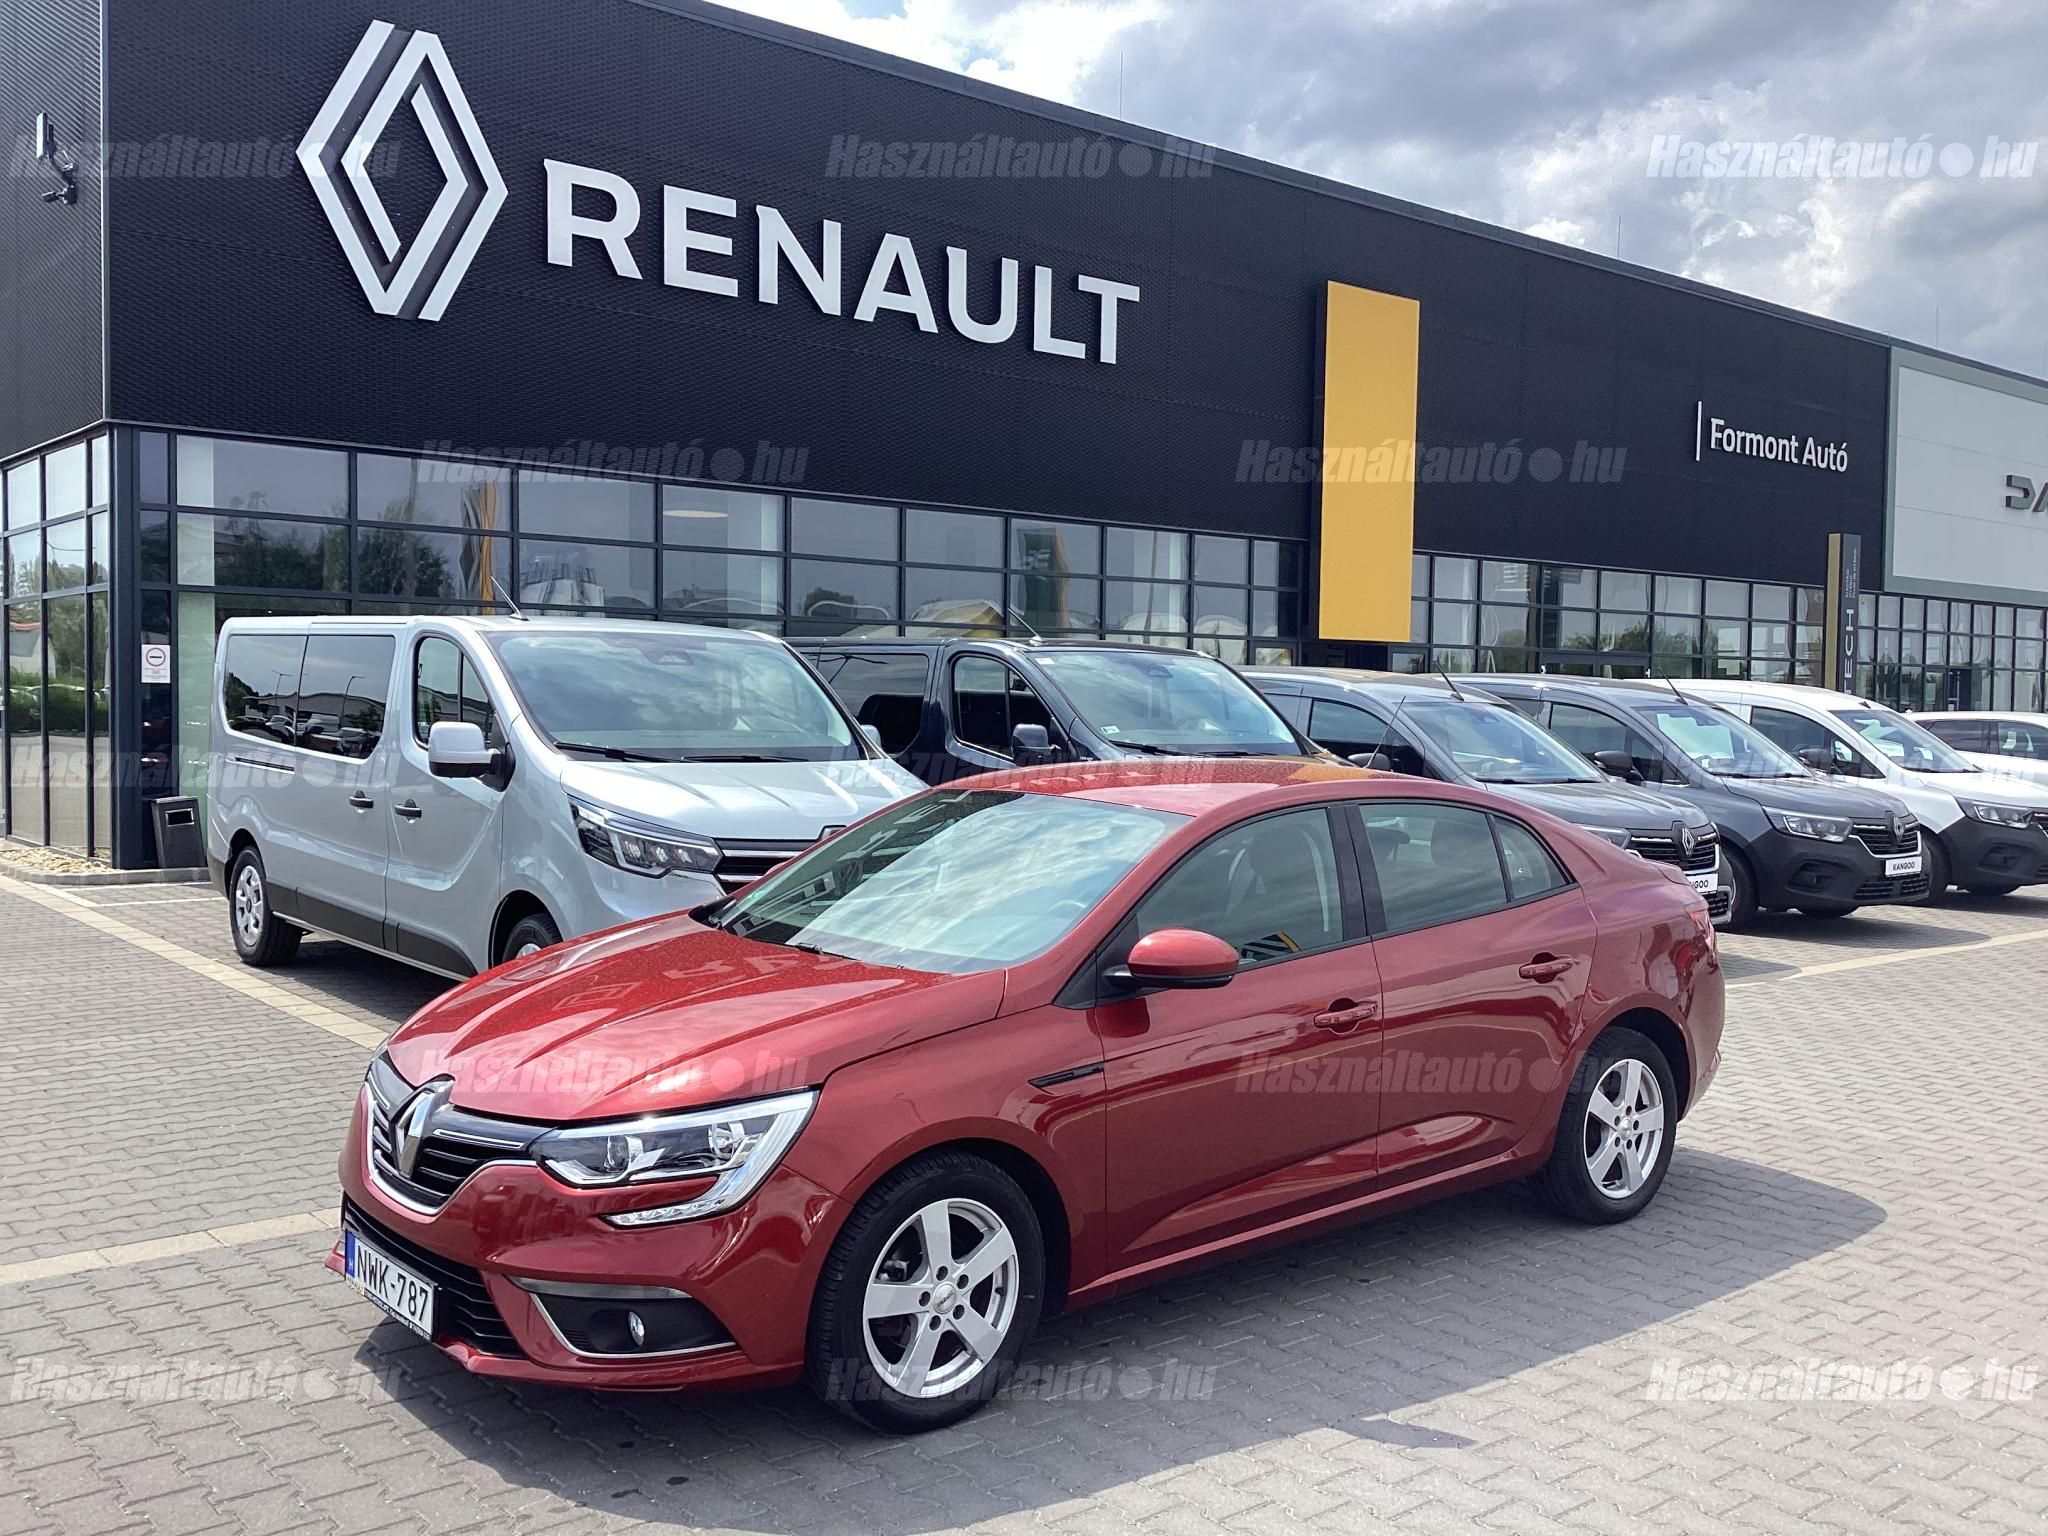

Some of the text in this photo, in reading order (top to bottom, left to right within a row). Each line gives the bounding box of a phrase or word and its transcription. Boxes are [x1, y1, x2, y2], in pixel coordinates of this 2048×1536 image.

[544, 158, 1140, 365] RENAULT
[1710, 417, 1848, 472] Formont Autó
[1892, 861, 1915, 871] KANGOO
[357, 1244, 429, 1322] NWK-787
